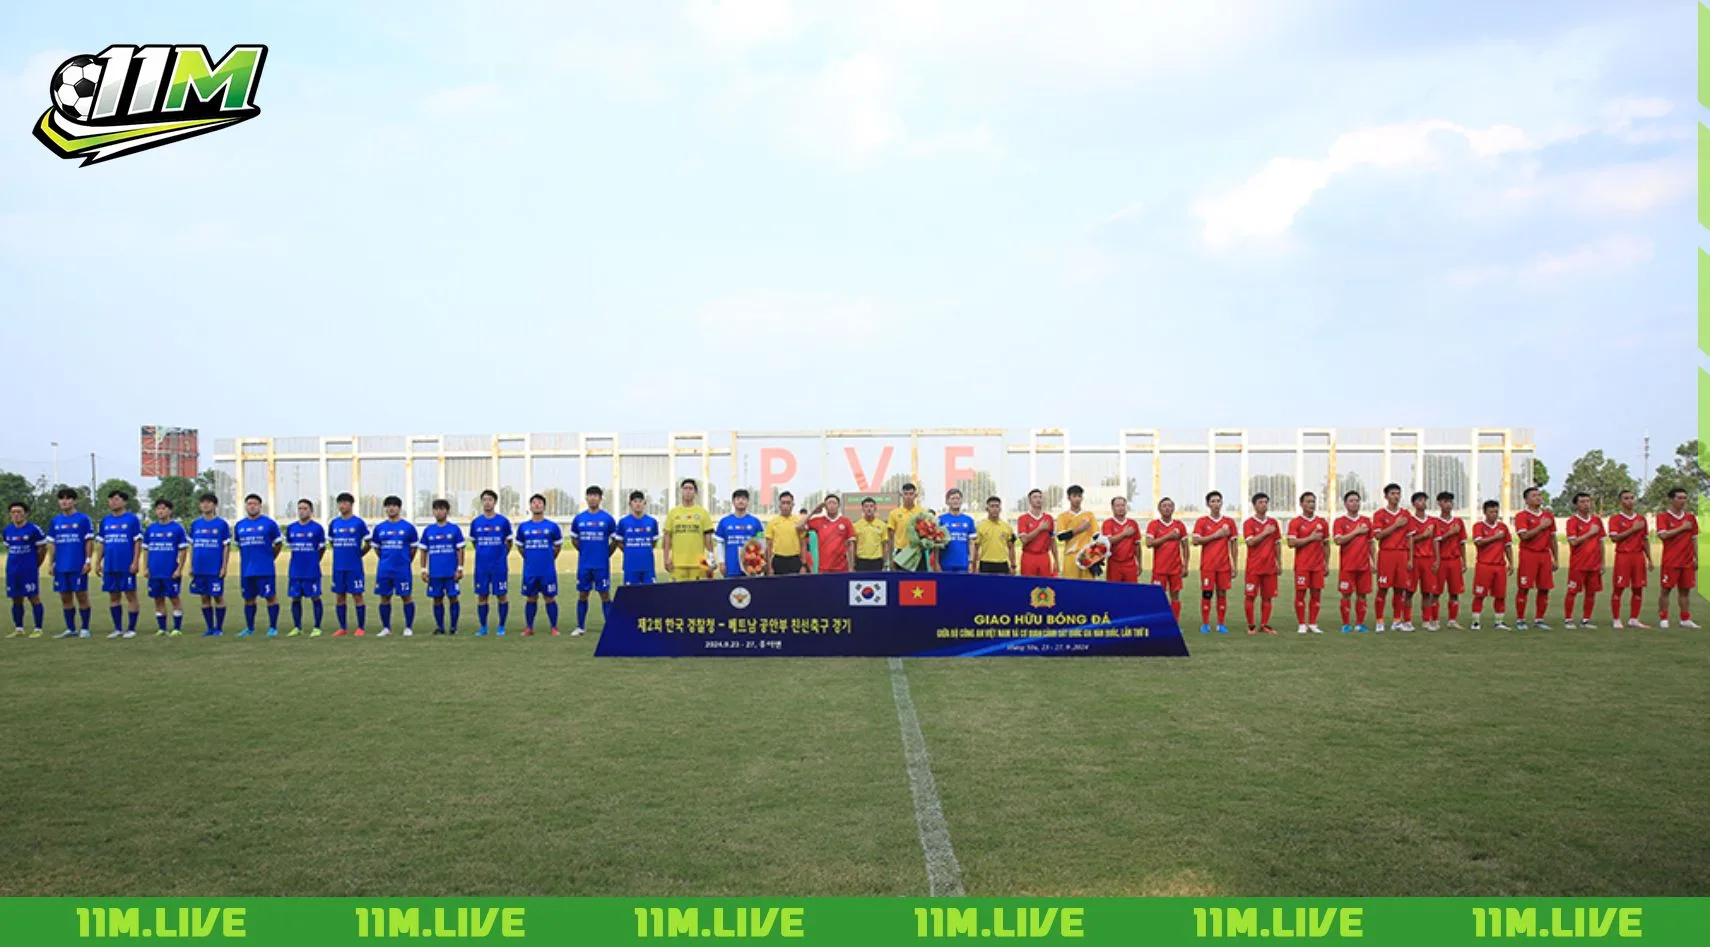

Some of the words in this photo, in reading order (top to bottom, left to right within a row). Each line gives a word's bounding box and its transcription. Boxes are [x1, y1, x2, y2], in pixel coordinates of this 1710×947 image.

[638, 616, 663, 634] 제2회
[665, 616, 684, 634] 한국
[687, 616, 716, 634] 경찰청
[728, 616, 757, 634] 베트남
[760, 616, 788, 634] 공안부
[791, 616, 830, 634] 친선축구
[832, 616, 851, 634] 경기
[974, 613, 1011, 625] GIAO
[1014, 611, 1043, 625] HỮU
[1046, 611, 1087, 625] BÓNG
[1091, 611, 1111, 625] ĐÁ
